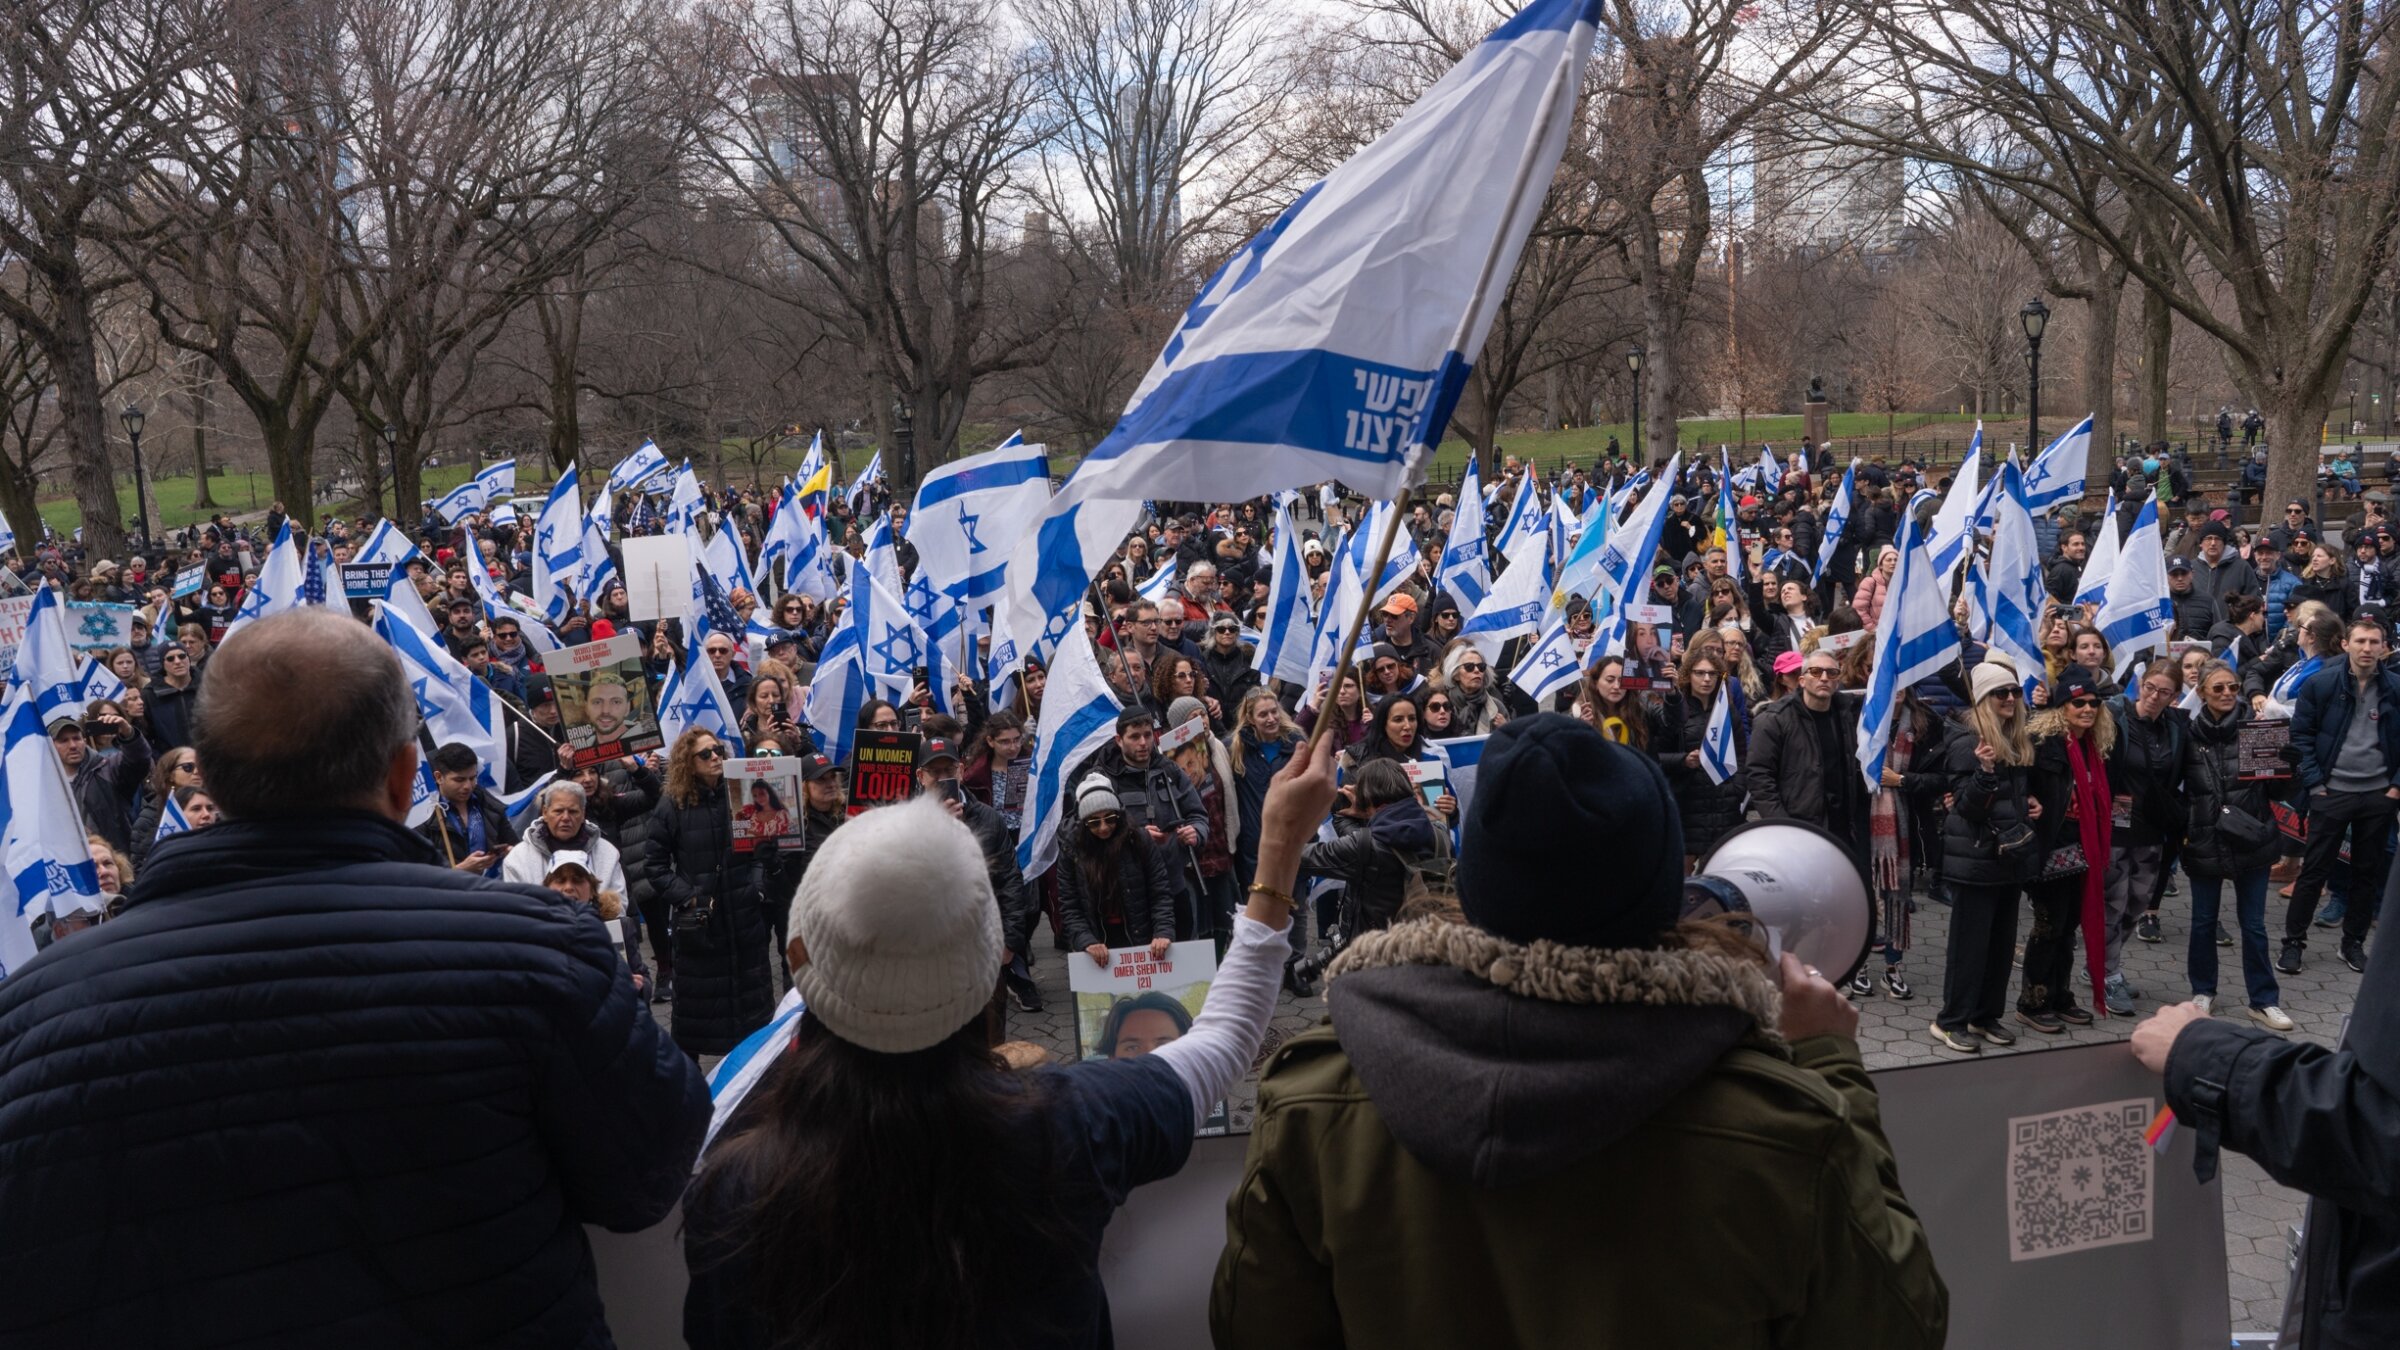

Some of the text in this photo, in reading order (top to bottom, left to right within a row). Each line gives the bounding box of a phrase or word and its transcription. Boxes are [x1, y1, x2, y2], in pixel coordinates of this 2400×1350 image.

[345, 570, 369, 580] BRING
[346, 580, 369, 590] HOME
[567, 724, 593, 739] BRING
[860, 747, 912, 764] UN WOMEN
[858, 763, 876, 773] YOUR
[877, 764, 902, 774] SILENCE
[856, 772, 910, 800] LOUD
[1114, 961, 1173, 978] OMER SHEM TOV
[1137, 976, 1152, 990] (21)
